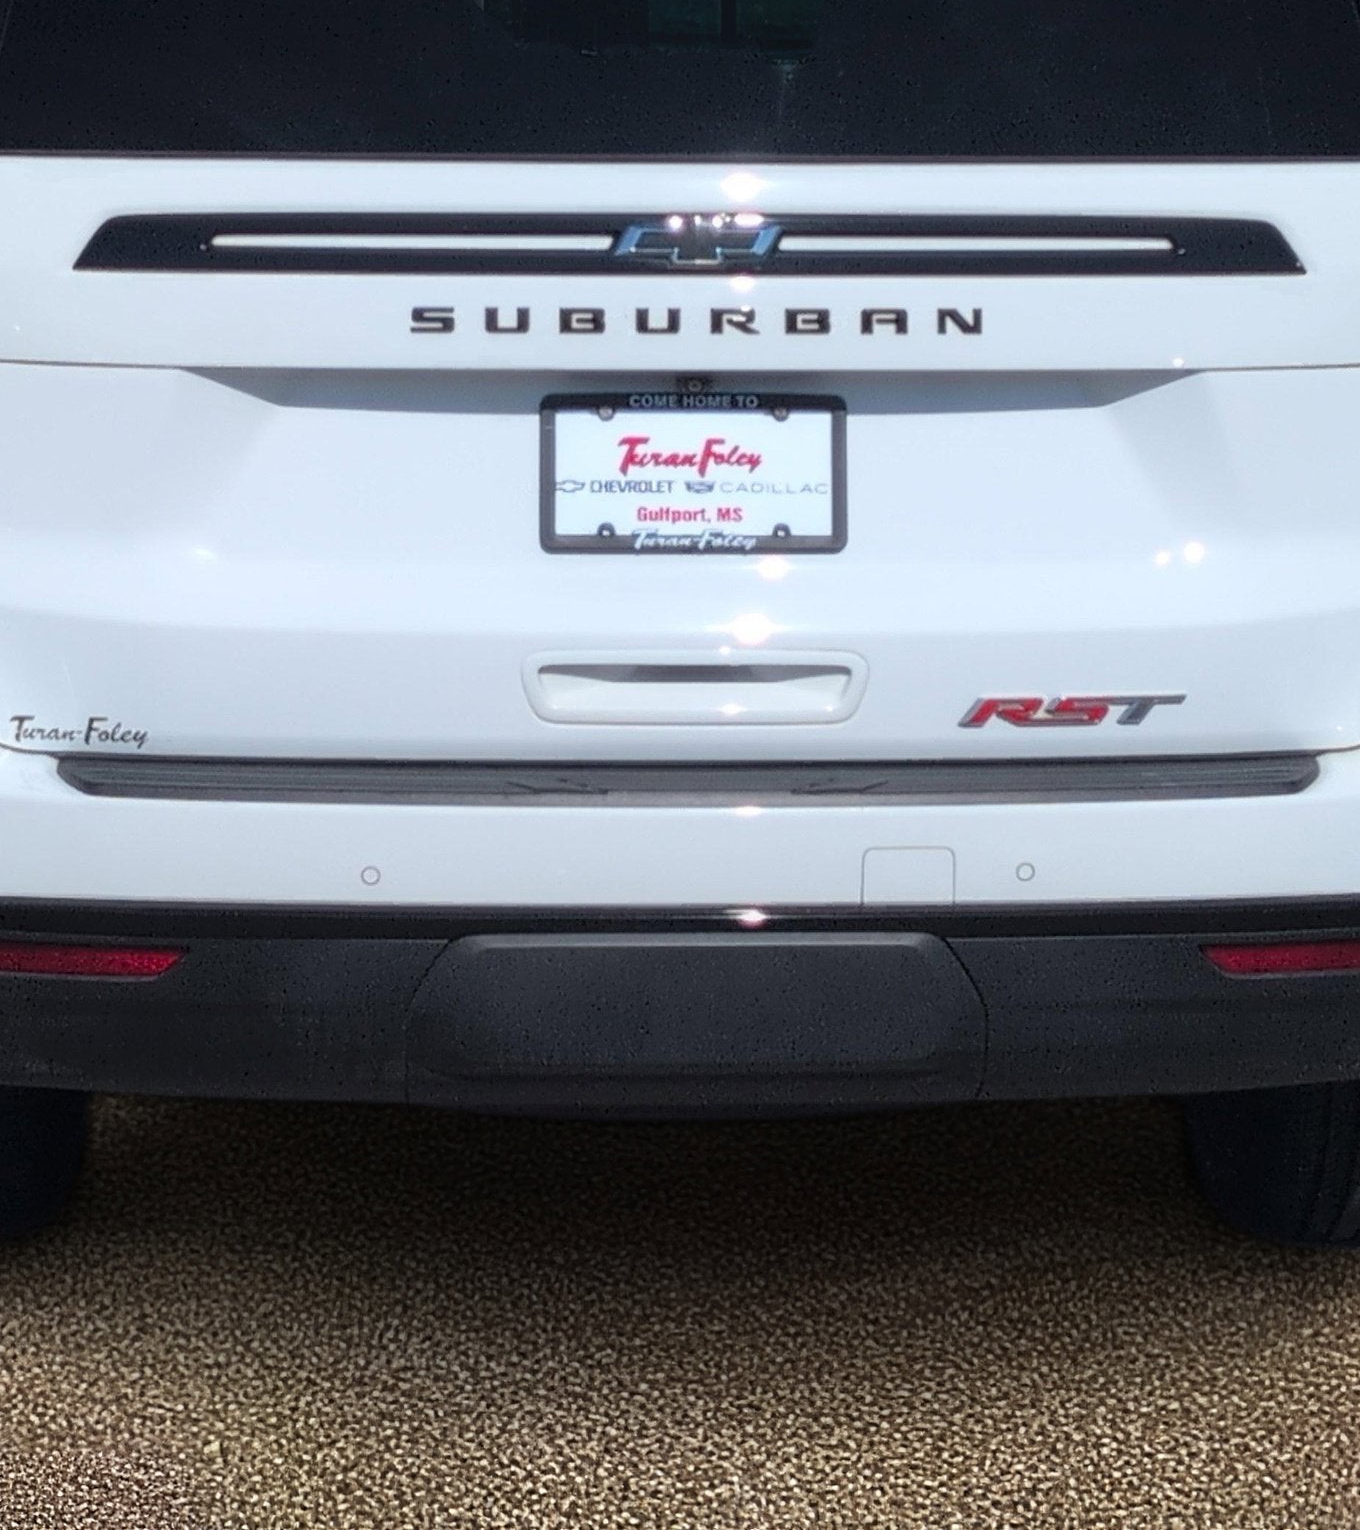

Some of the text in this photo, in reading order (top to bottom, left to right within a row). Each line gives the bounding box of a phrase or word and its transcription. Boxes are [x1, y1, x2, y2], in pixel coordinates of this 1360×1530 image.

[408, 306, 984, 336] SUBURBAN
[628, 393, 760, 410] COME HOME TO
[589, 479, 829, 496] CHEVROLET CADILLAC
[636, 506, 744, 525] Gulfport, MS
[956, 693, 1188, 729] RST
